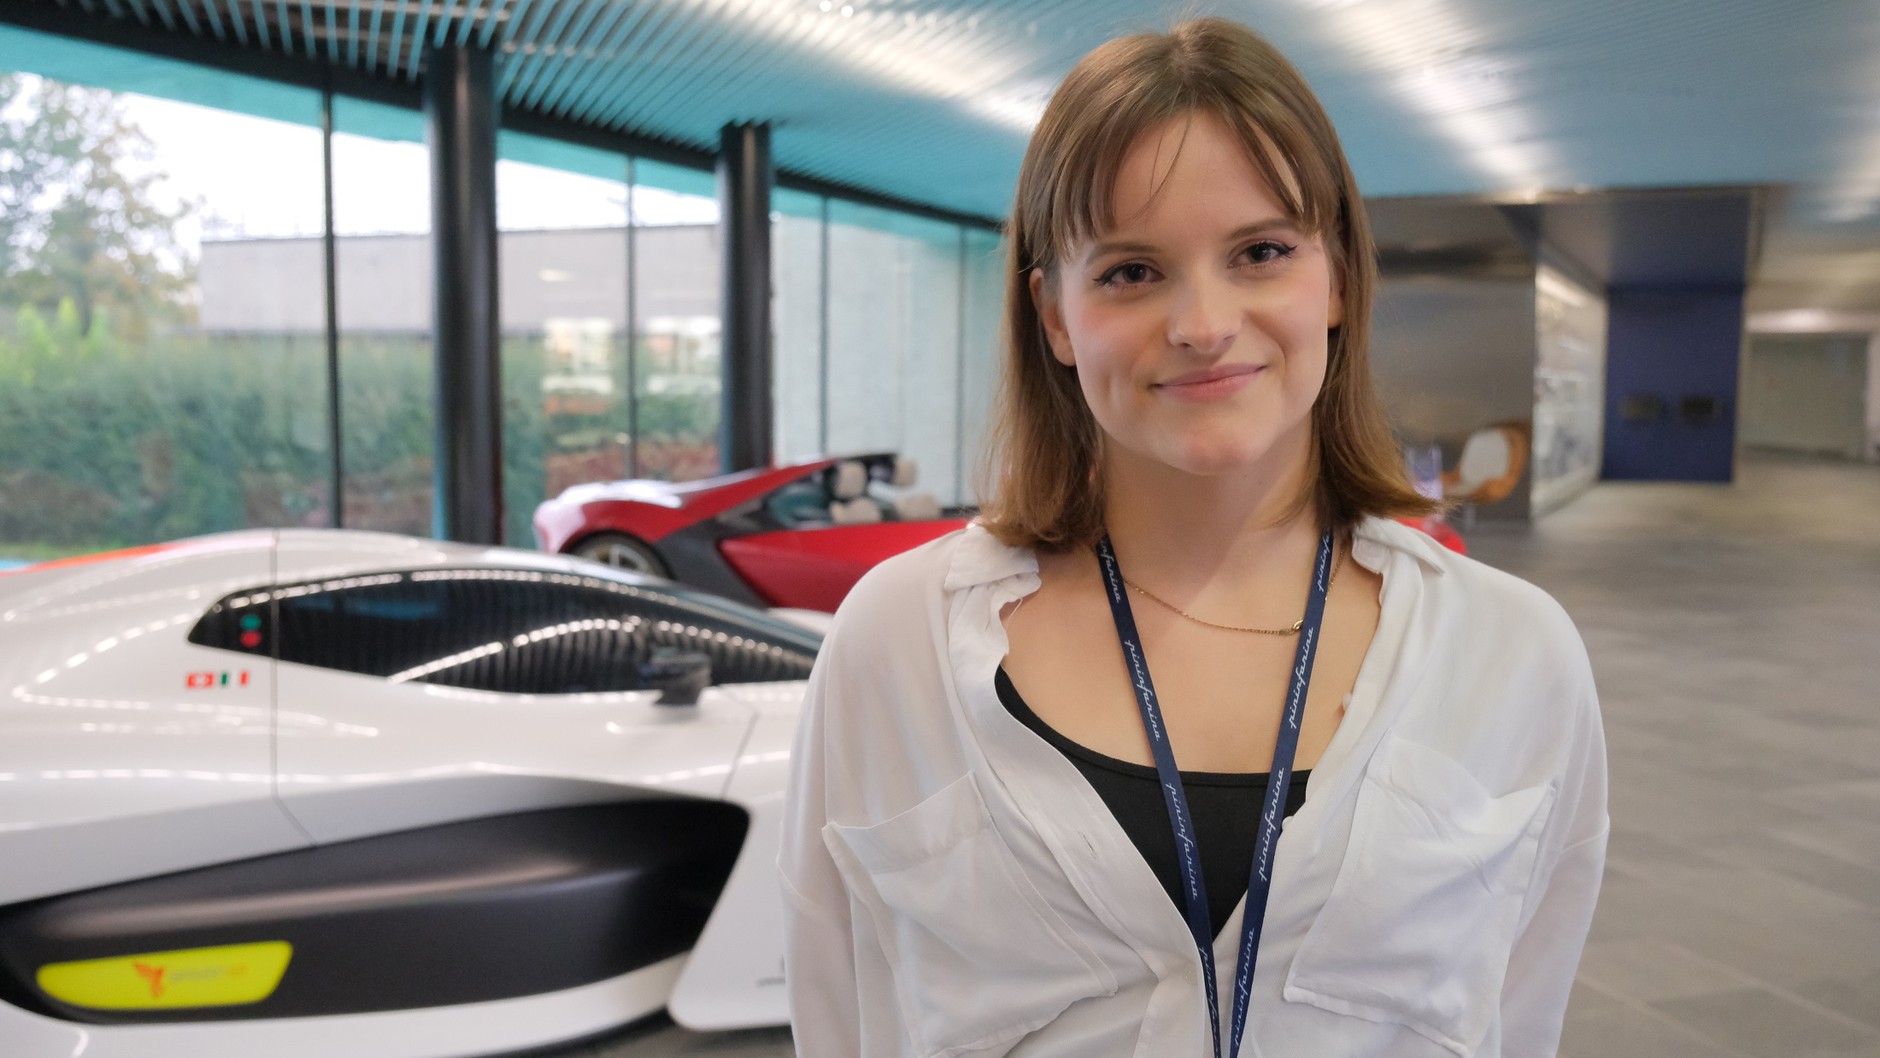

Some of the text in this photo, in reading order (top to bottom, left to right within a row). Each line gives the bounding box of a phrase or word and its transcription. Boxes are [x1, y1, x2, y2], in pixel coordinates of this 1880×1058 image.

[1318, 533, 1330, 592] pininfa
[1124, 639, 1161, 742] pininfarina
[1288, 626, 1314, 730] pininfarina
[1165, 782, 1198, 901] pininfarina
[1258, 767, 1285, 883] pininfarina
[1235, 928, 1255, 1047] pininfarina
